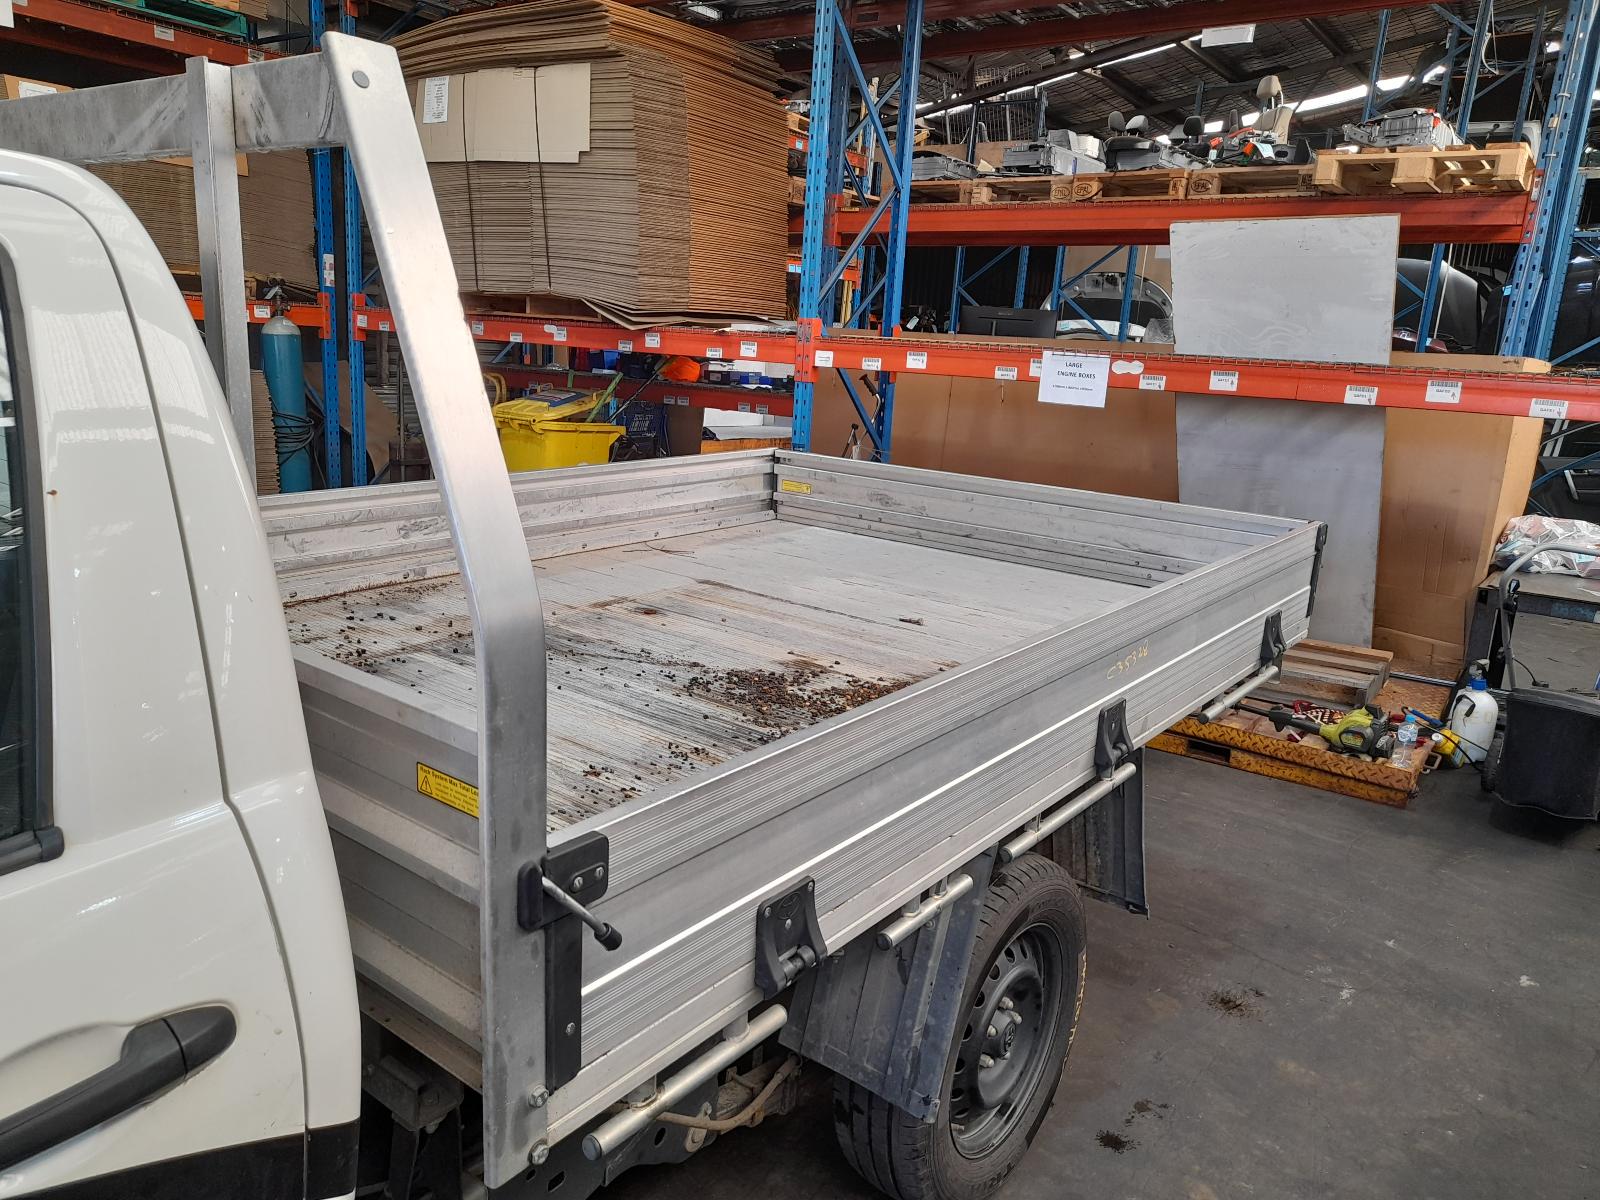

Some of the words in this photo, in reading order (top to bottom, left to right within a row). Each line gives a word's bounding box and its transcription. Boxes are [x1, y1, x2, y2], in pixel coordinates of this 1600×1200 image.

[1065, 361, 1083, 369] LARGE
[1057, 370, 1077, 379] ENGINE
[1078, 372, 1096, 380] BOXES
[432, 771, 448, 782] System
[449, 778, 458, 787] Max
